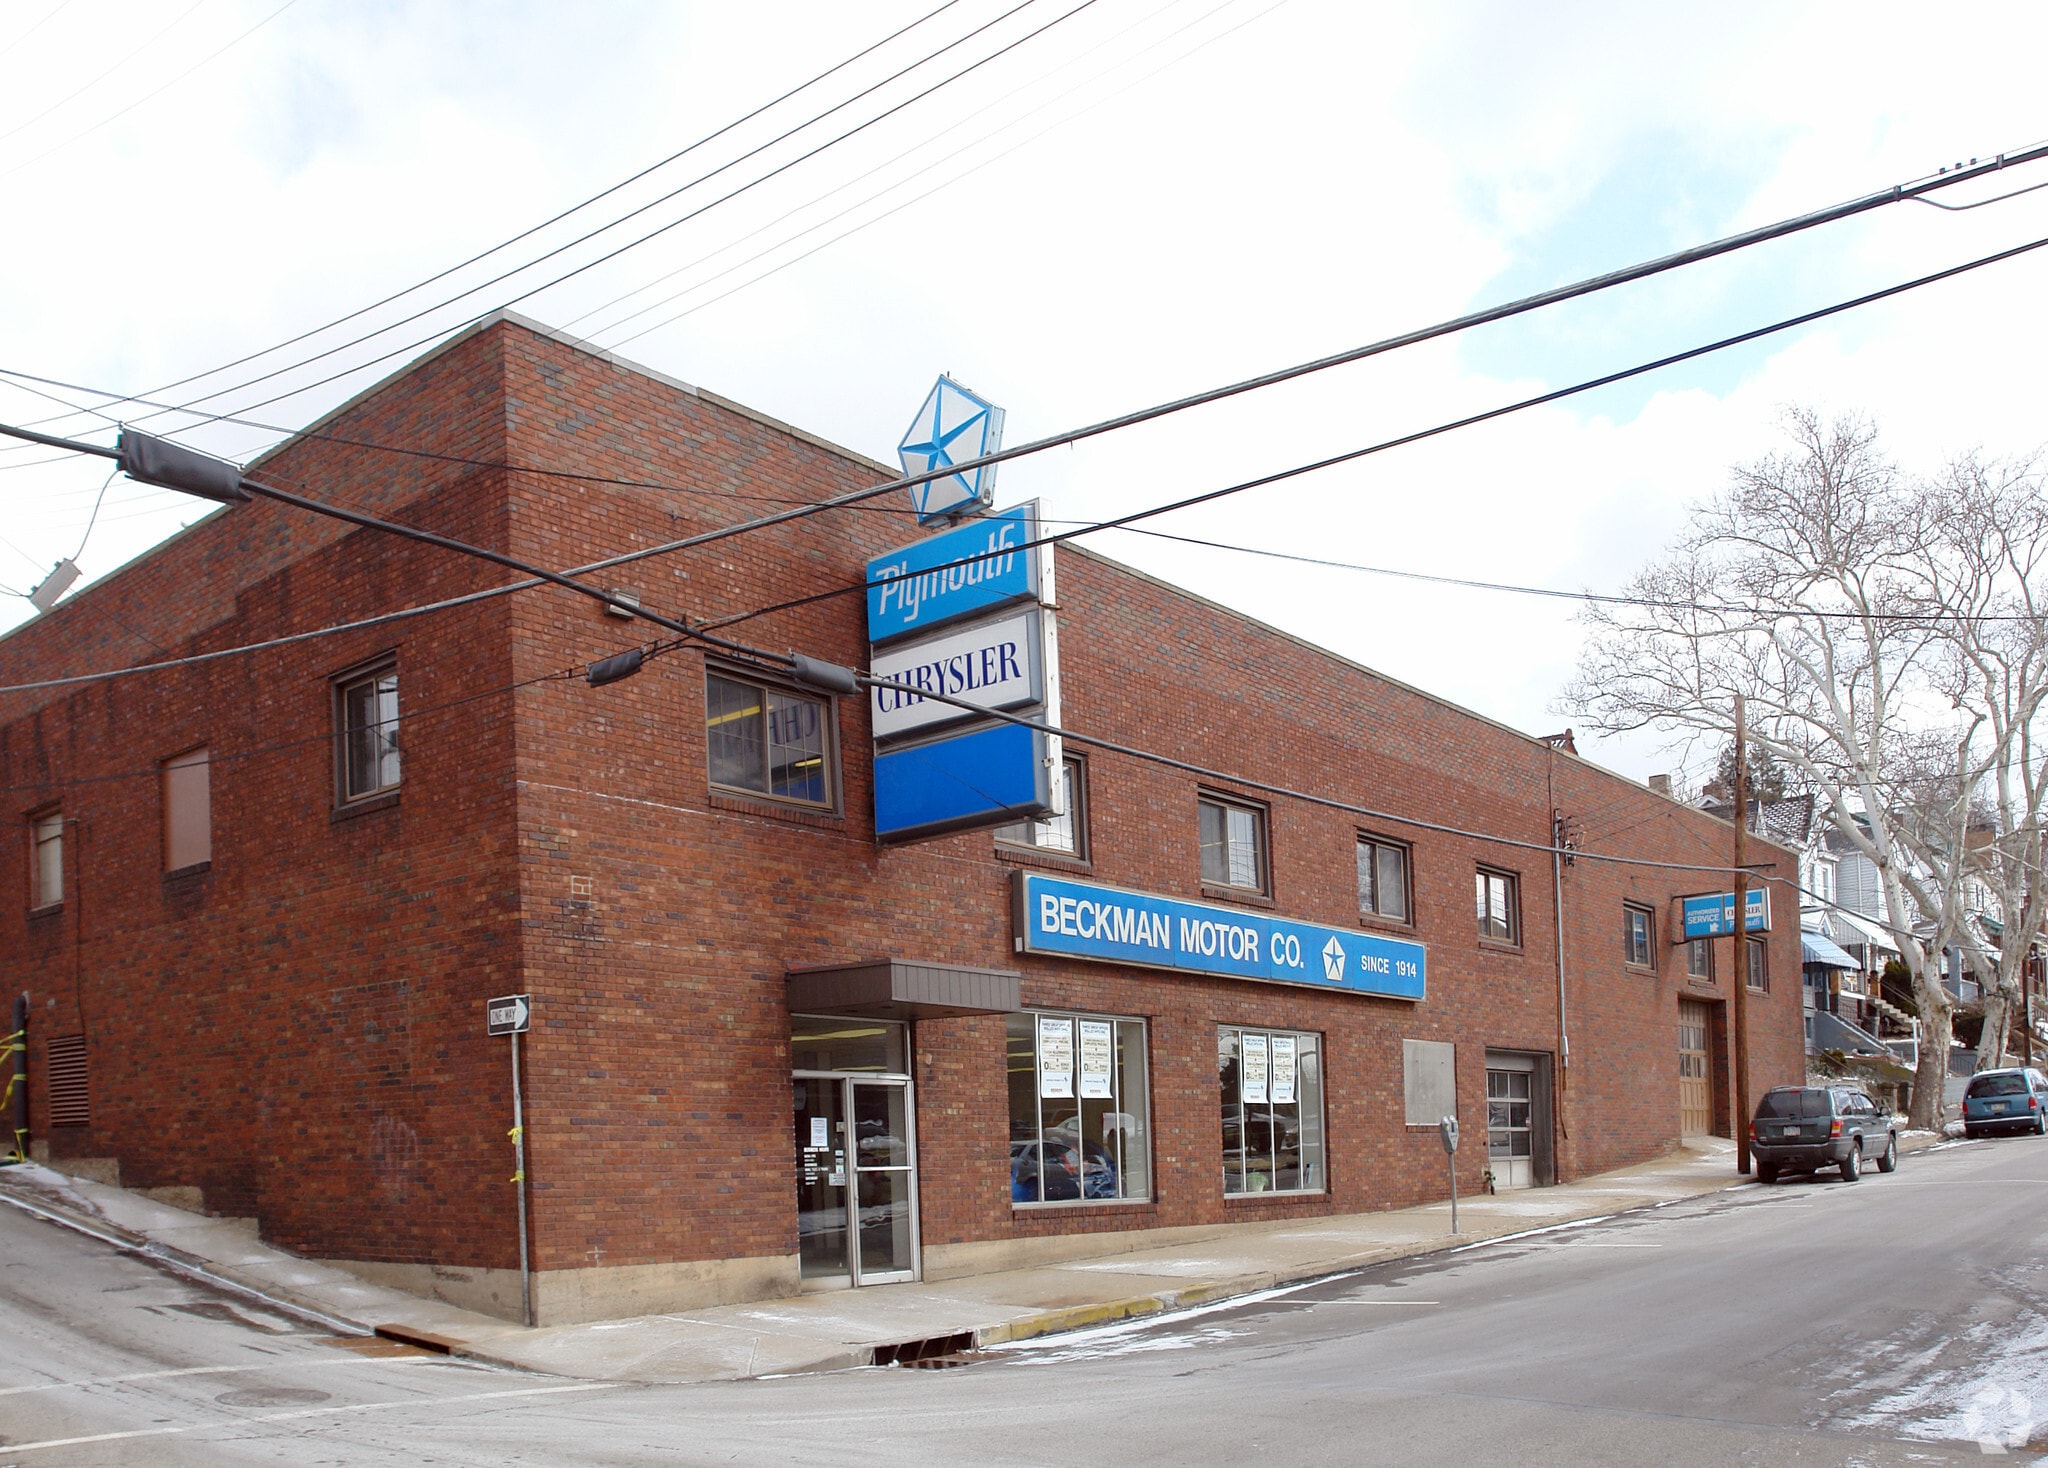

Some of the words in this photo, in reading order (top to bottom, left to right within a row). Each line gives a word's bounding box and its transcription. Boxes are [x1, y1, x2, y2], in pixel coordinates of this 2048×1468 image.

[875, 522, 1015, 623] Plymouth
[877, 641, 1023, 713] CHRYSLER
[1688, 907, 1719, 916] AUTHORIZED
[1688, 913, 1719, 924] SERVICE
[1039, 893, 1171, 950] BECKMAN
[1179, 916, 1259, 963] MOTOR
[1270, 931, 1305, 969] CO.
[1361, 954, 1390, 974] SINCE
[1395, 960, 1417, 978] 1914
[492, 1010, 502, 1023] ONE
[505, 1008, 516, 1021] WAY
